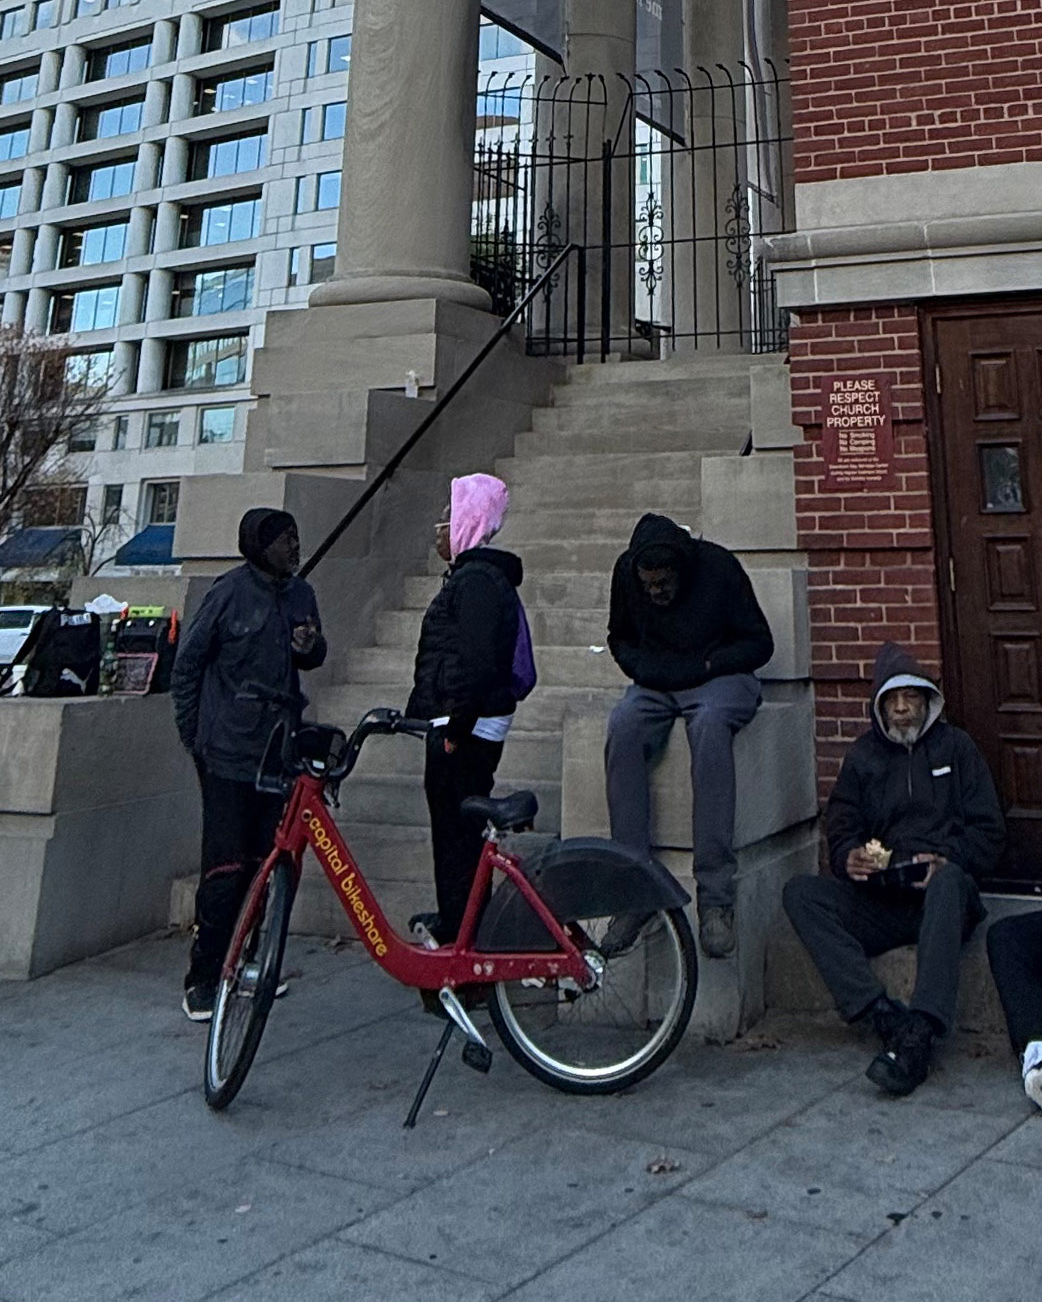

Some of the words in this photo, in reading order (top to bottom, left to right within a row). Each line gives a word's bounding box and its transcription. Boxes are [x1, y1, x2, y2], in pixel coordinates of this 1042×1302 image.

[833, 379, 876, 392] PLEASE
[829, 391, 881, 404] RESPECT
[831, 403, 880, 416] CHURCH
[826, 414, 886, 428] PROPERTY
[309, 817, 349, 876] capital
[340, 872, 388, 957] bikeshare
